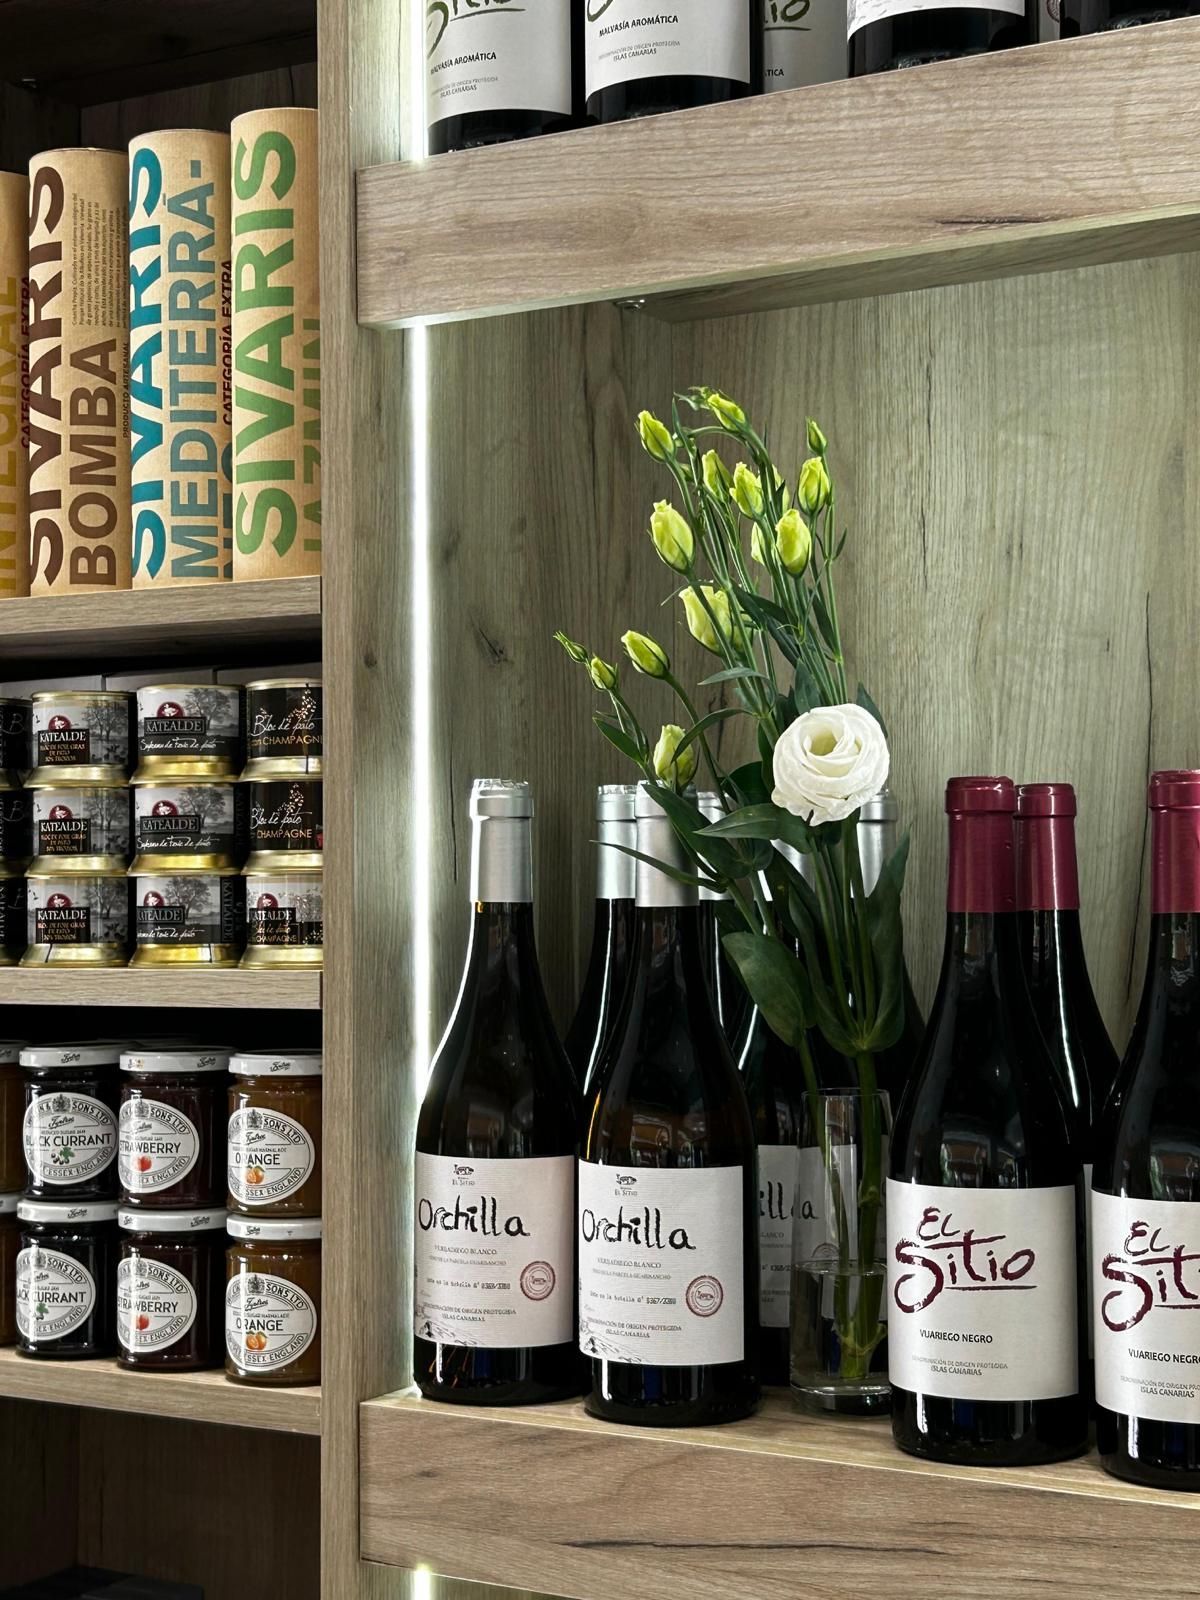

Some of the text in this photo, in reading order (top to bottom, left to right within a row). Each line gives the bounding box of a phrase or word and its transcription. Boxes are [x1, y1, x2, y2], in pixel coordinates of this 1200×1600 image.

[599, 14, 678, 37] MALVASÍA AROMÁTICA
[454, 51, 496, 66] AROMÁTICA
[628, 48, 656, 58] CANARIAS
[235, 130, 298, 557] SIVARIS
[129, 147, 167, 580] SIVARIS
[30, 166, 65, 586] SIVARIS
[68, 338, 118, 586] BOMBA
[39, 731, 86, 743] KATEALDE
[146, 719, 201, 732] KATEALDE
[263, 735, 322, 746] CHAMPAGN
[41, 822, 88, 832] KATEALDE
[142, 818, 196, 831] KATEALDE
[256, 828, 313, 839] CHAMPAGNE
[37, 910, 87, 920] KATEALDE
[72, 1102, 96, 1115] SONS
[96, 1111, 112, 1125] LTD
[151, 1108, 172, 1122] SONS
[172, 1115, 186, 1133] LTD
[53, 1133, 112, 1147] CURRANT
[264, 1118, 301, 1144] SONS LTD
[75, 1149, 109, 1175] ENGLAND
[152, 1158, 186, 1184] ENGLAND
[235, 1154, 281, 1165] OANGE
[246, 1169, 301, 1197] SSEX ENGLAND
[418, 1195, 530, 1236] Orchilla
[582, 1206, 696, 1250] Orchilla
[48, 1259, 83, 1283] SONS LTD
[634, 1260, 661, 1268] BLANCO
[894, 1229, 1035, 1313] Sitio
[148, 1266, 184, 1292] SONS LTD
[1101, 1244, 1200, 1332] Sit
[266, 1283, 304, 1309] SONS LTD
[50, 1305, 83, 1331] ENGLAND
[150, 1316, 183, 1342] ENGLAND
[269, 1335, 304, 1361] ENGLAND
[962, 1334, 993, 1343] NEGRO
[931, 1365, 982, 1376] ISLAS CANARIAS
[1140, 1386, 1195, 1398] ISLAS CANARIAS
